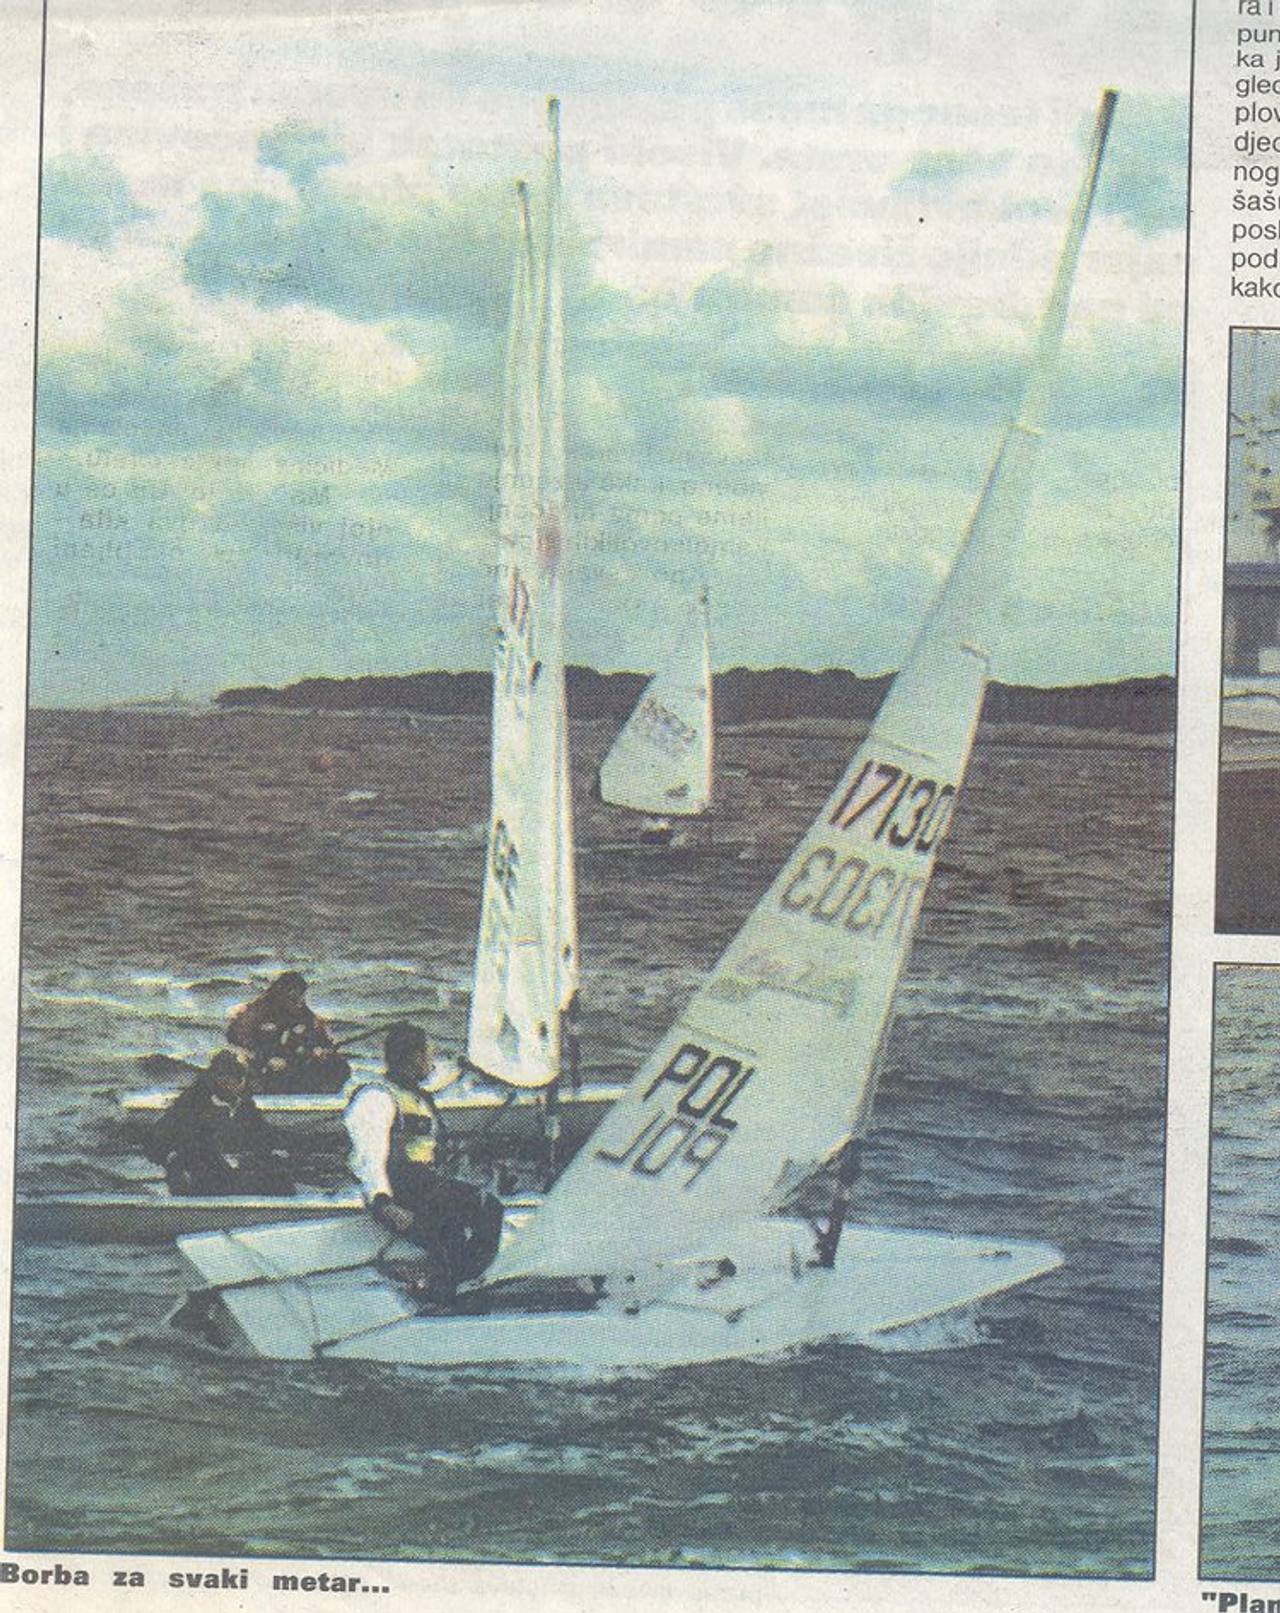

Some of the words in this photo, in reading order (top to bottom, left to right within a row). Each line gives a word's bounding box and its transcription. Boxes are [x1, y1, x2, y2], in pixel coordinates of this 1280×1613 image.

[1236, 49, 1265, 68] ka
[642, 1042, 756, 1131] POL
[0, 1562, 90, 1586] Borba
[112, 1569, 146, 1587] za
[168, 1568, 250, 1590] svaki
